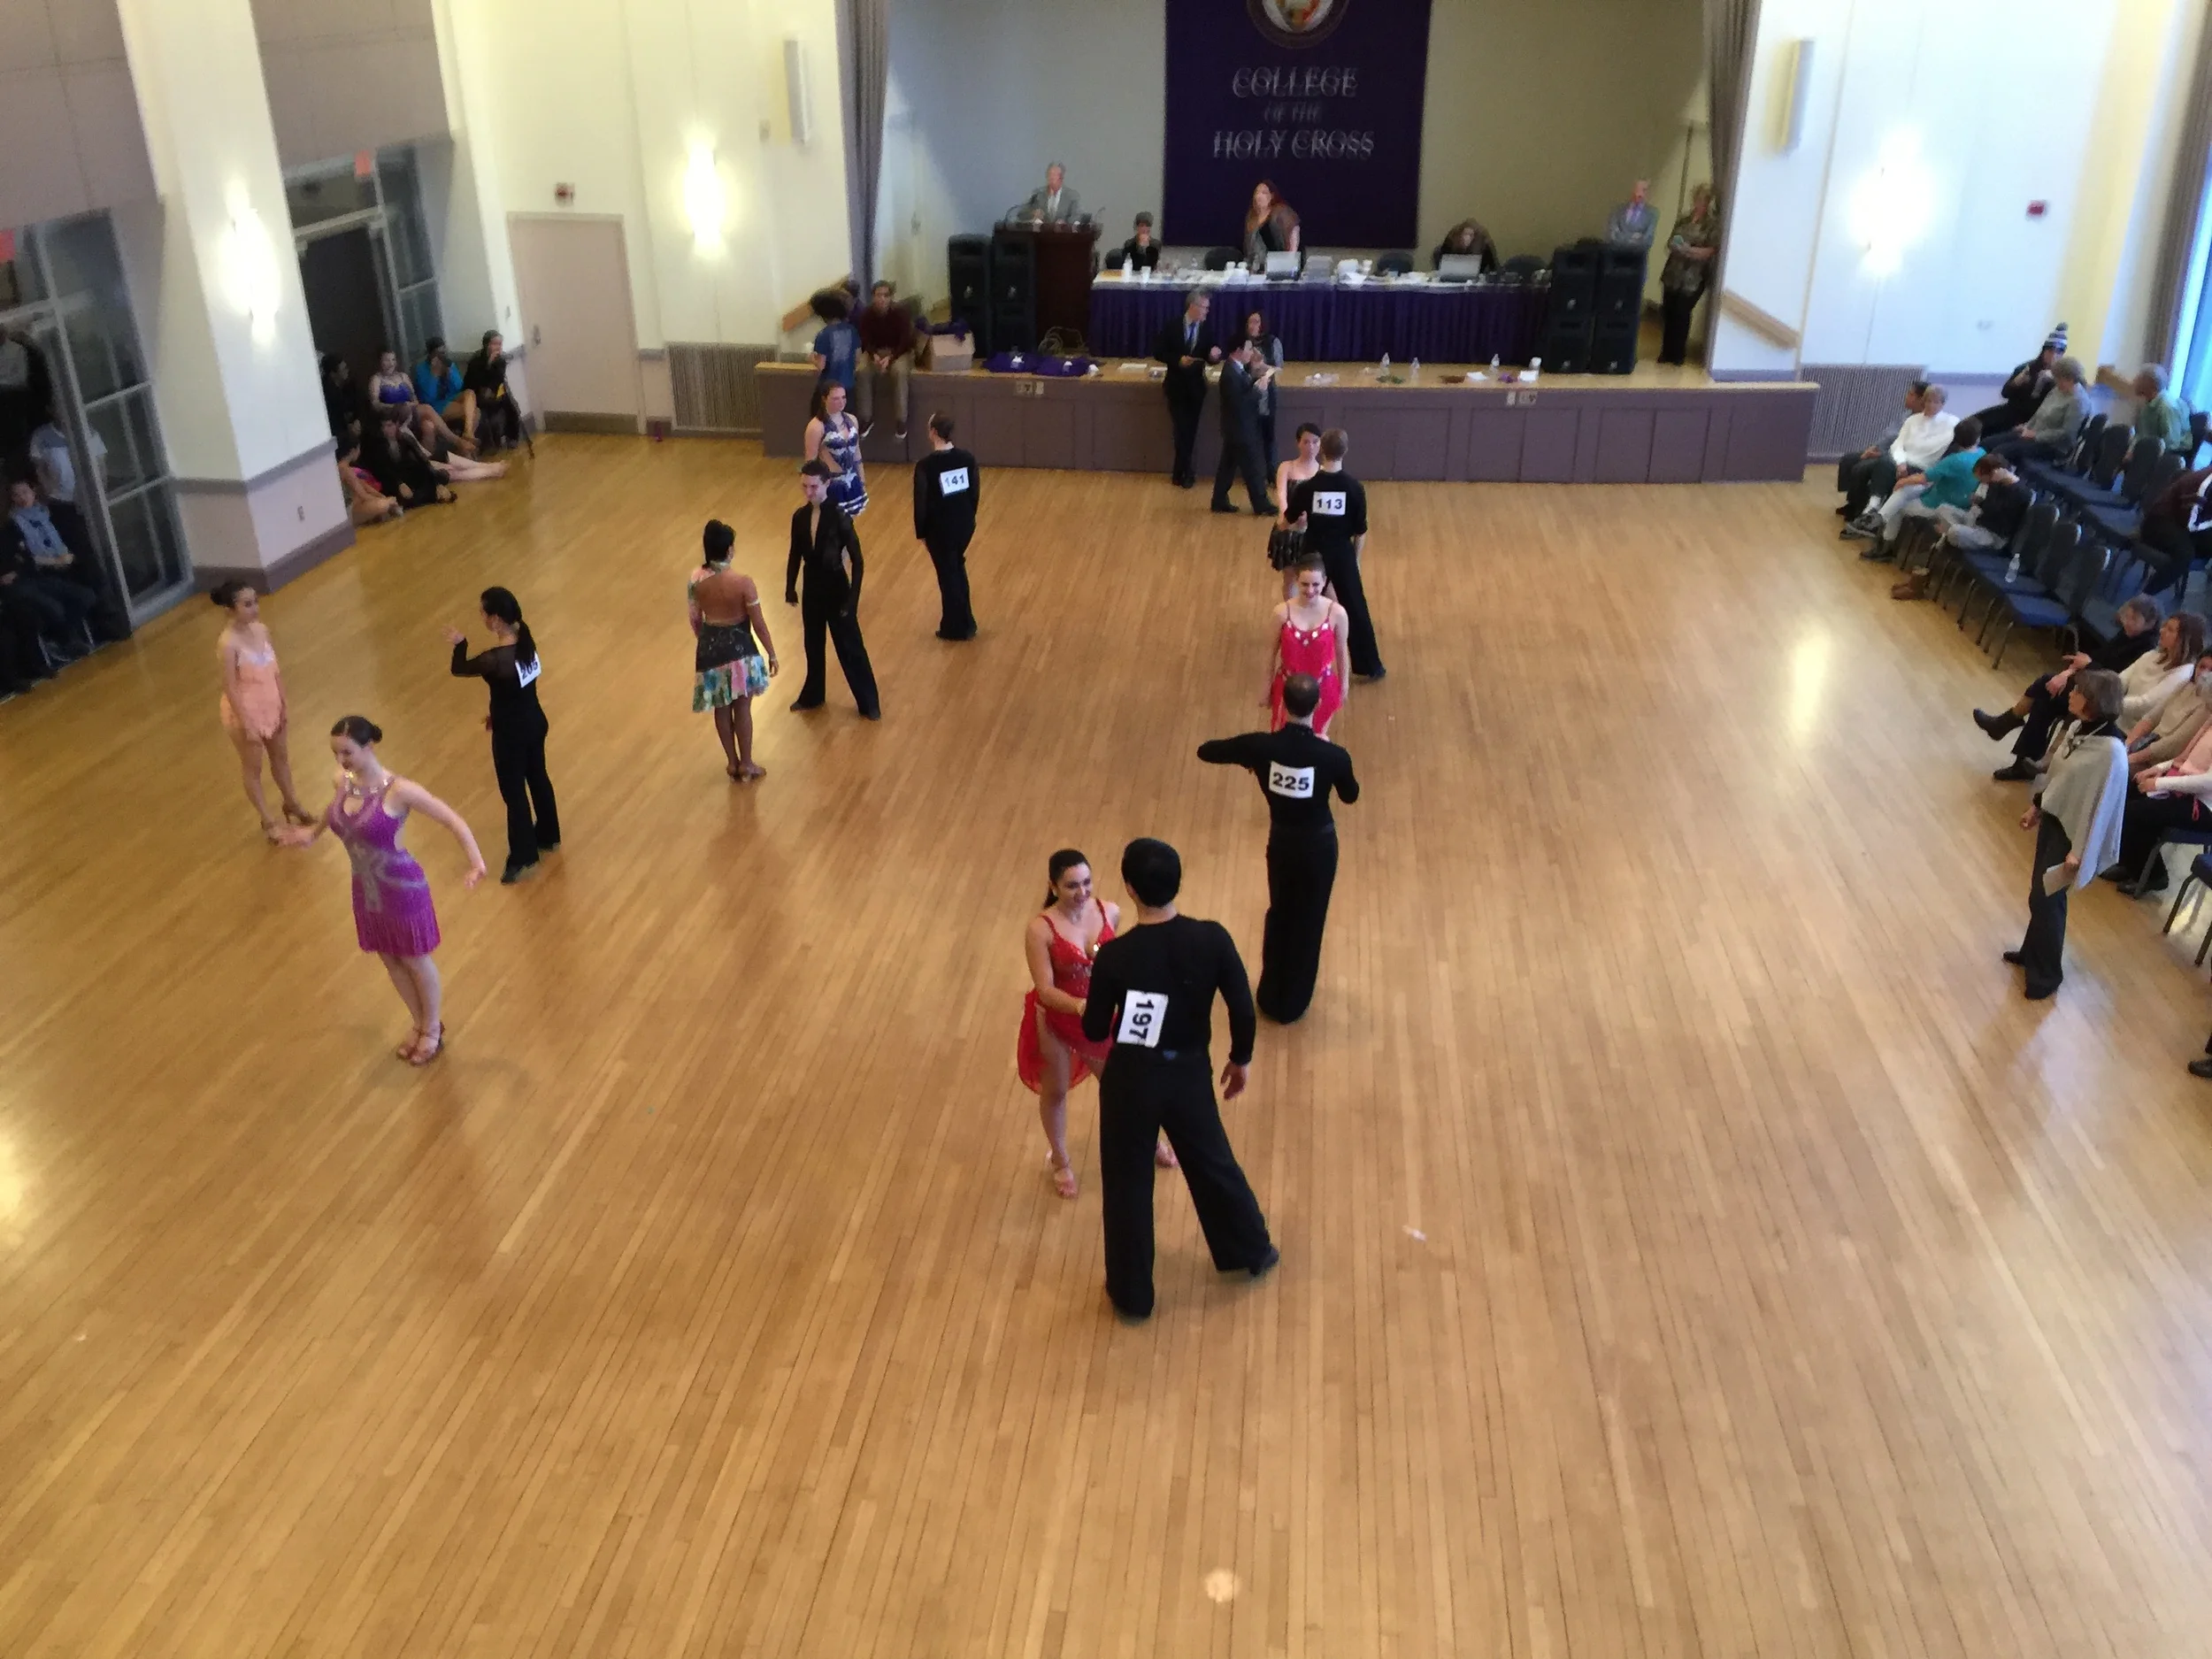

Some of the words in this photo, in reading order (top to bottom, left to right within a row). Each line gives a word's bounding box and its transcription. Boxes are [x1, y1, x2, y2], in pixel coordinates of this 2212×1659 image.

[1233, 66, 1357, 97] COLLEGE
[1213, 130, 1286, 159] HOLY
[1292, 130, 1374, 159] CROSS
[944, 474, 964, 488] 141
[1317, 498, 1342, 510] 113
[1272, 772, 1310, 791] 225
[1129, 999, 1154, 1040] 197
